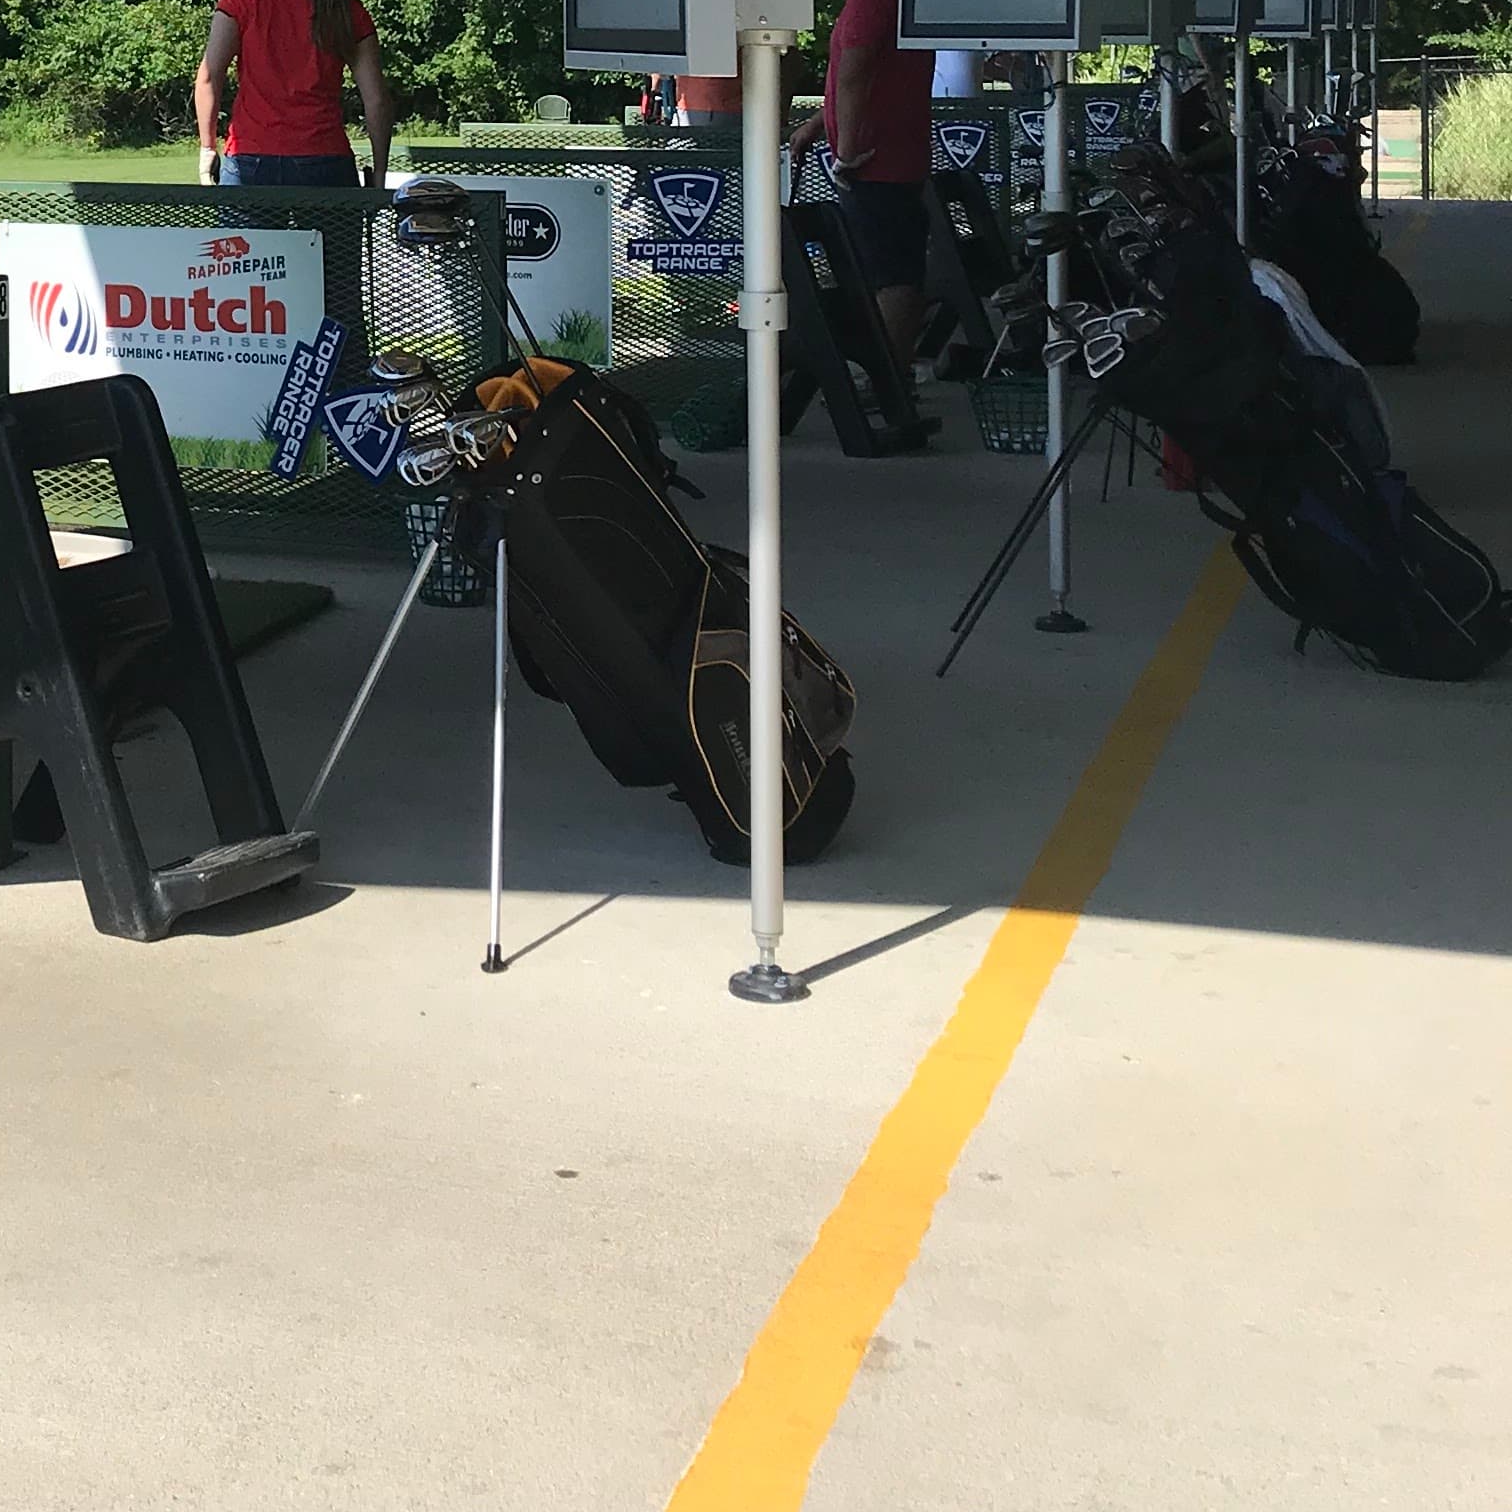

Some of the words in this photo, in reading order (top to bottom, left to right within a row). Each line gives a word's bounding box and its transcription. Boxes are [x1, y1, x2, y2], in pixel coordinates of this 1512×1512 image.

[631, 243, 744, 256] TOPTRACER
[188, 255, 286, 280] RAPIDREPAIR
[656, 257, 723, 270] RANGE
[261, 270, 287, 282] TEAM
[0, 282, 7, 317] 8
[104, 284, 287, 335] Dutch
[105, 332, 287, 349] ENTERPRISES
[105, 347, 163, 360] PLUMBING
[173, 350, 224, 363] HEATING
[234, 352, 287, 365] COOLING
[272, 349, 314, 437] RANGE
[277, 329, 341, 474] TOPTRACER
